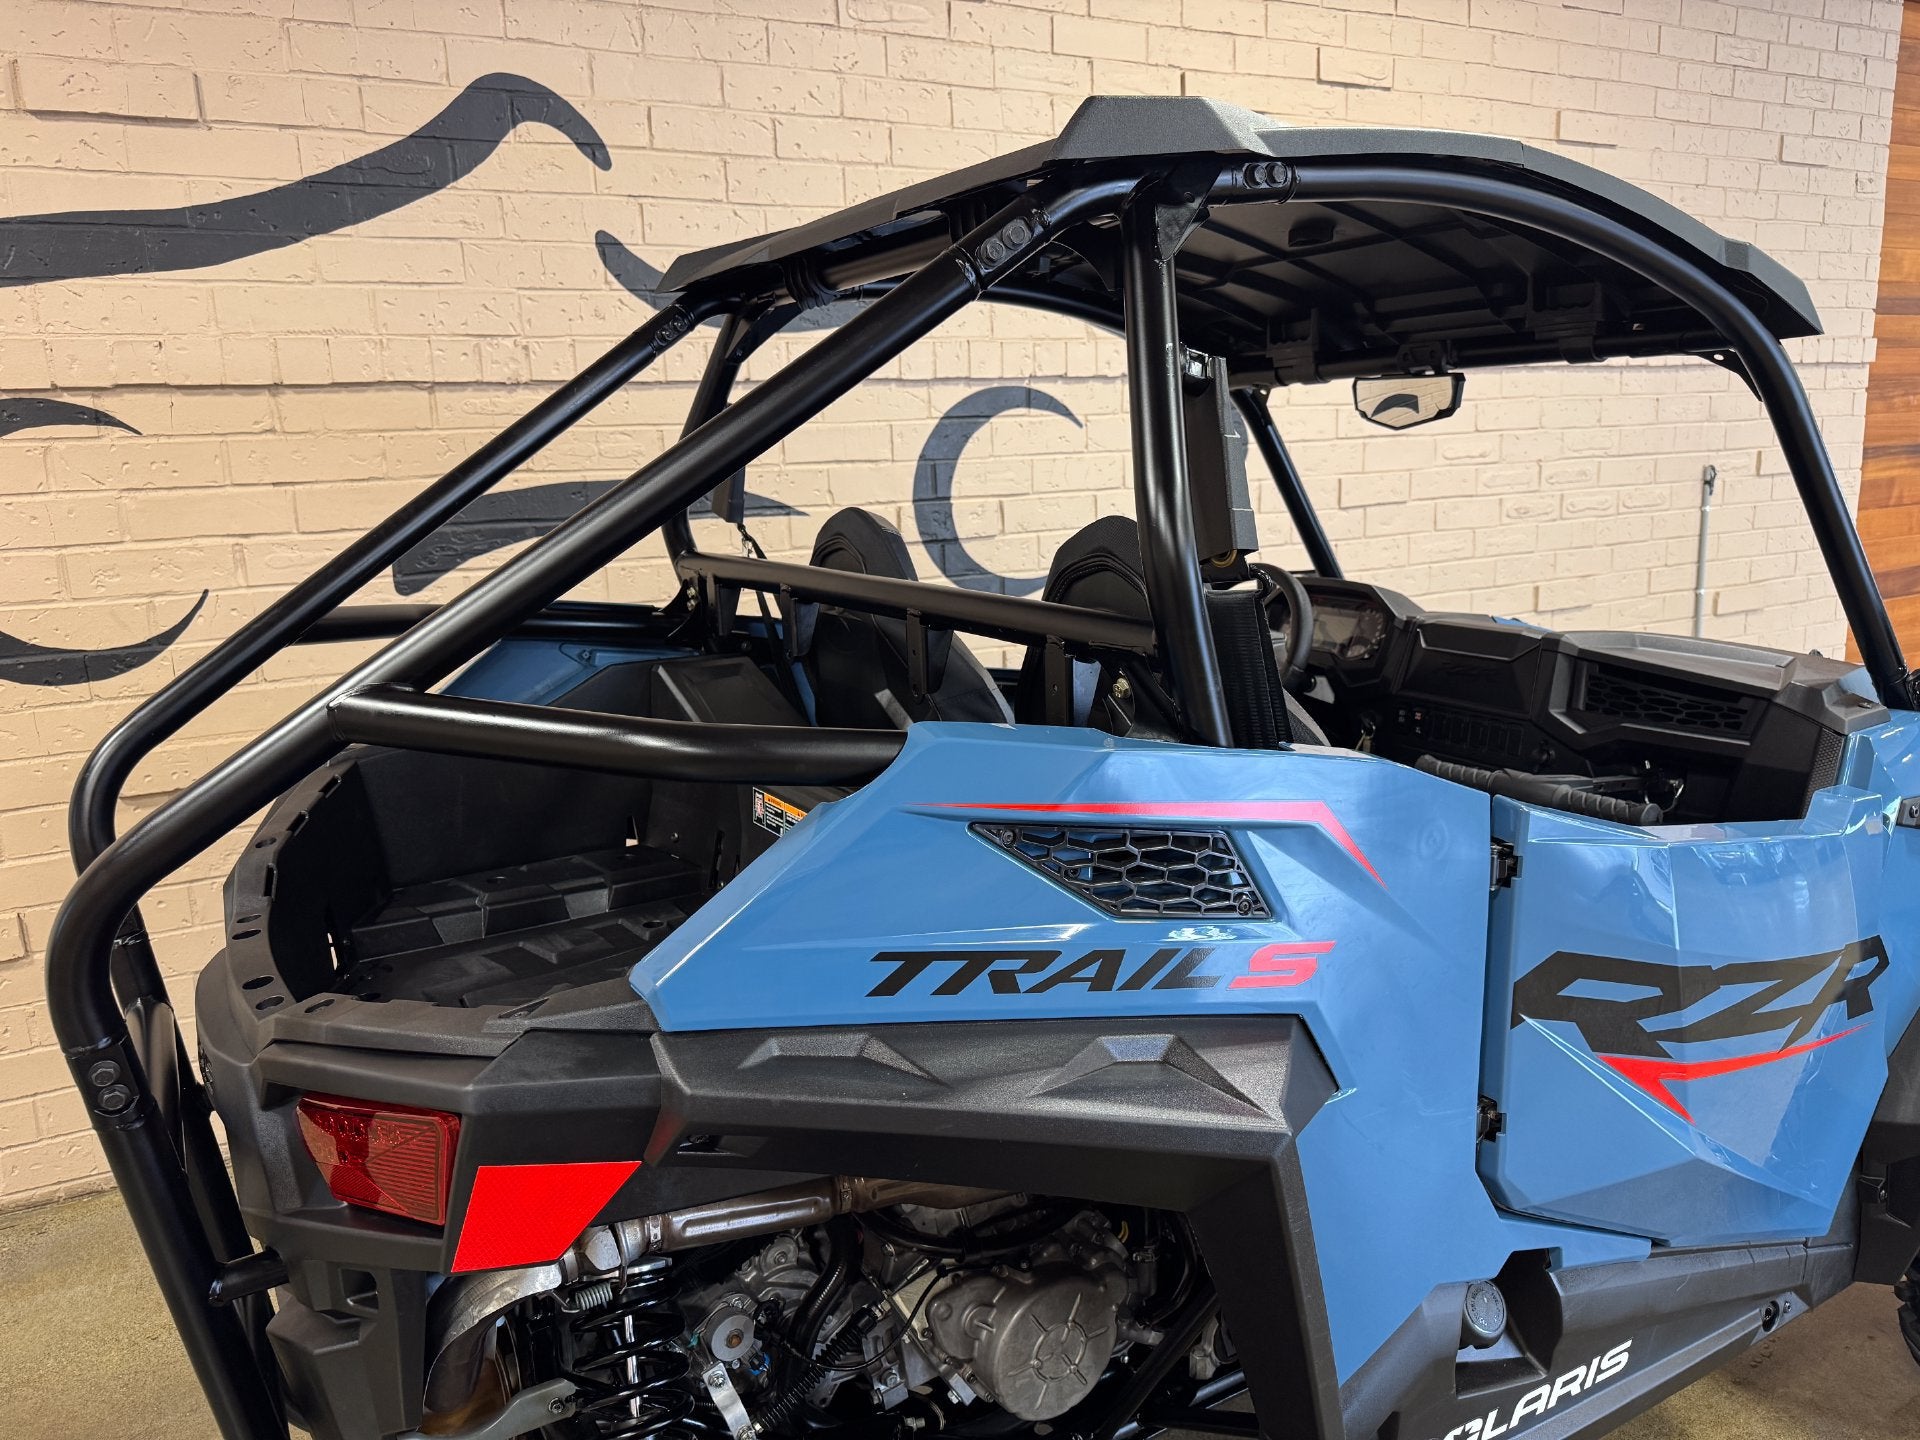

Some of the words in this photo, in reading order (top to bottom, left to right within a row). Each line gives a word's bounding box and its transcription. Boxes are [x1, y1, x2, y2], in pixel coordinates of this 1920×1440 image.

[865, 946, 1224, 997] TRAIL
[1226, 940, 1336, 990] S
[1510, 934, 1890, 1060] RZR
[1441, 1338, 1633, 1440] OLARIS
